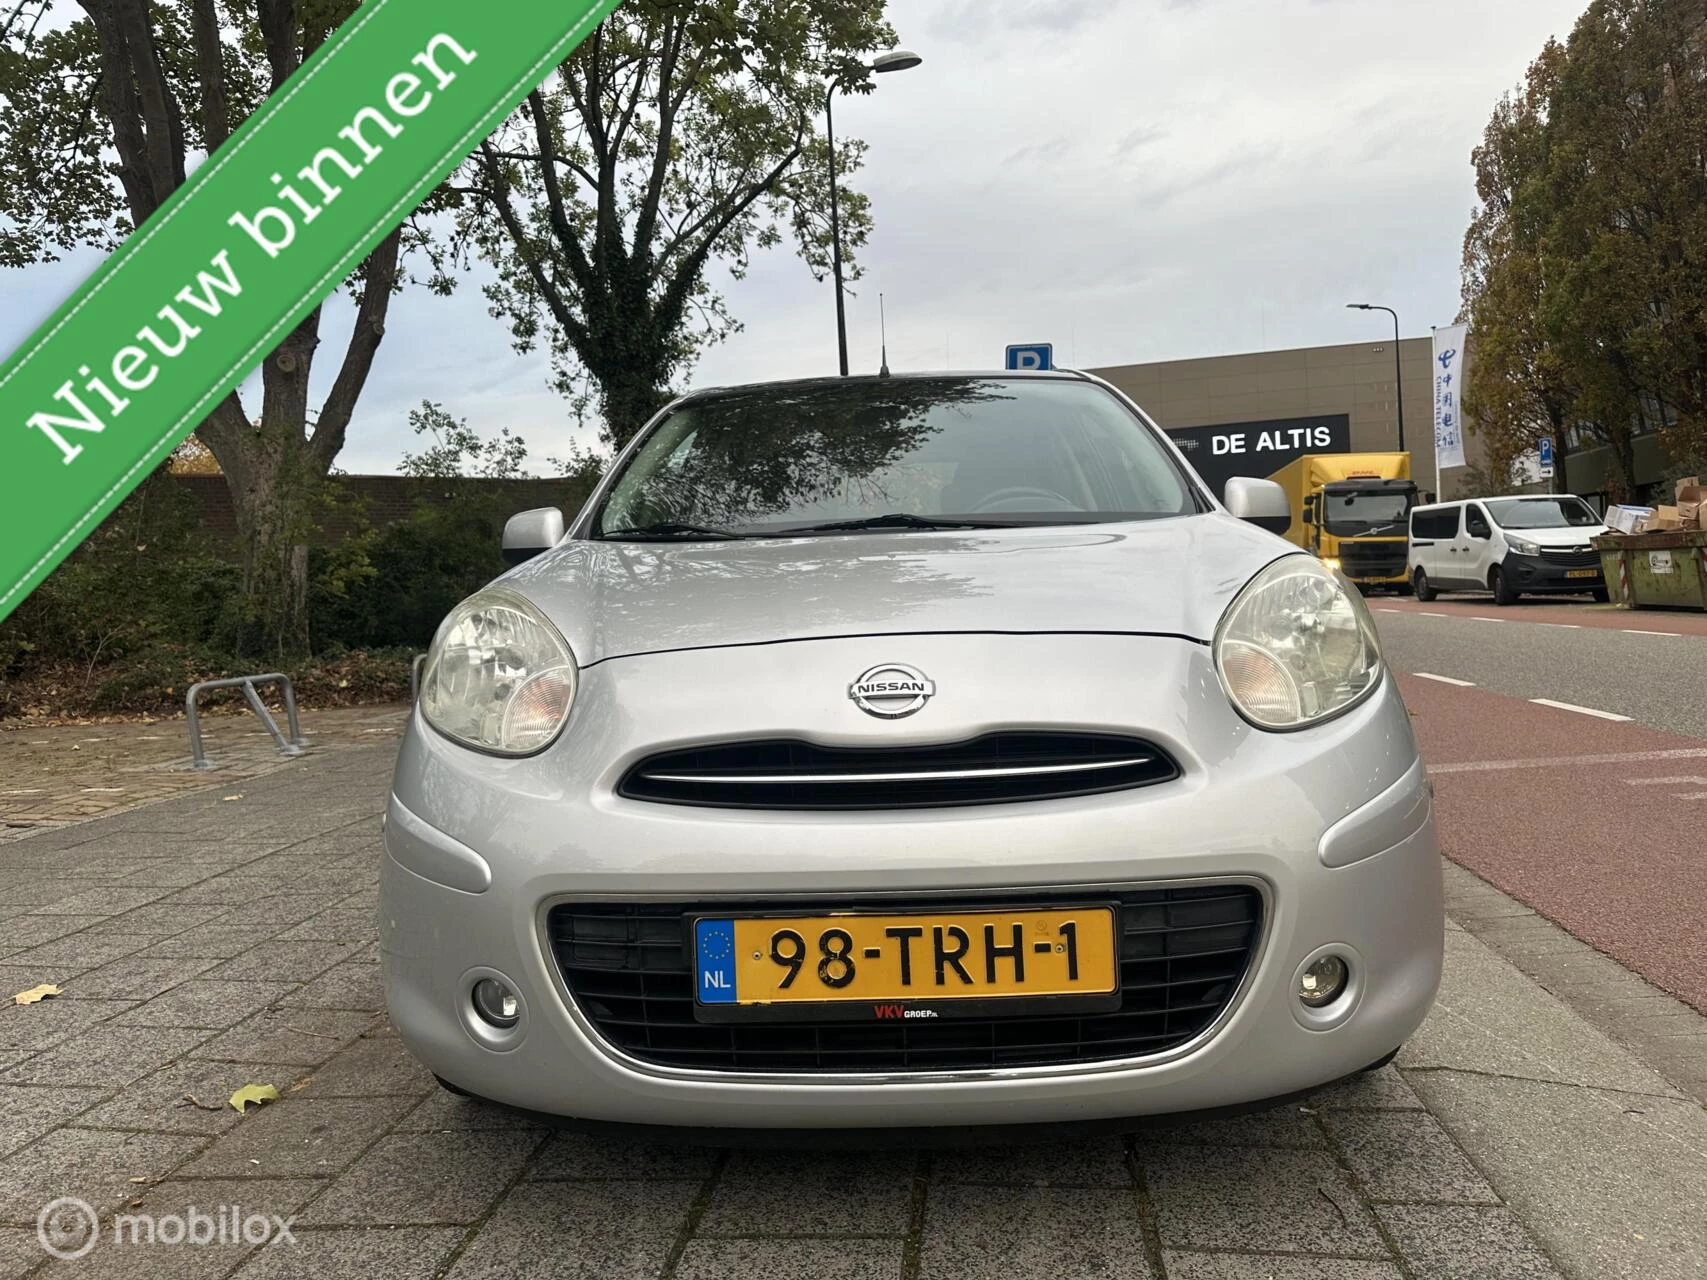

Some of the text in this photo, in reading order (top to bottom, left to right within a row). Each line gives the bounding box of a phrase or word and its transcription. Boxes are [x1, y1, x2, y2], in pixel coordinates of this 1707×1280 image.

[1212, 426, 1331, 455] DE ALTIS
[1542, 440, 1549, 455] P
[857, 682, 925, 694] NISSAN
[770, 920, 1079, 989] 98-TRH-1
[703, 970, 731, 989] NL
